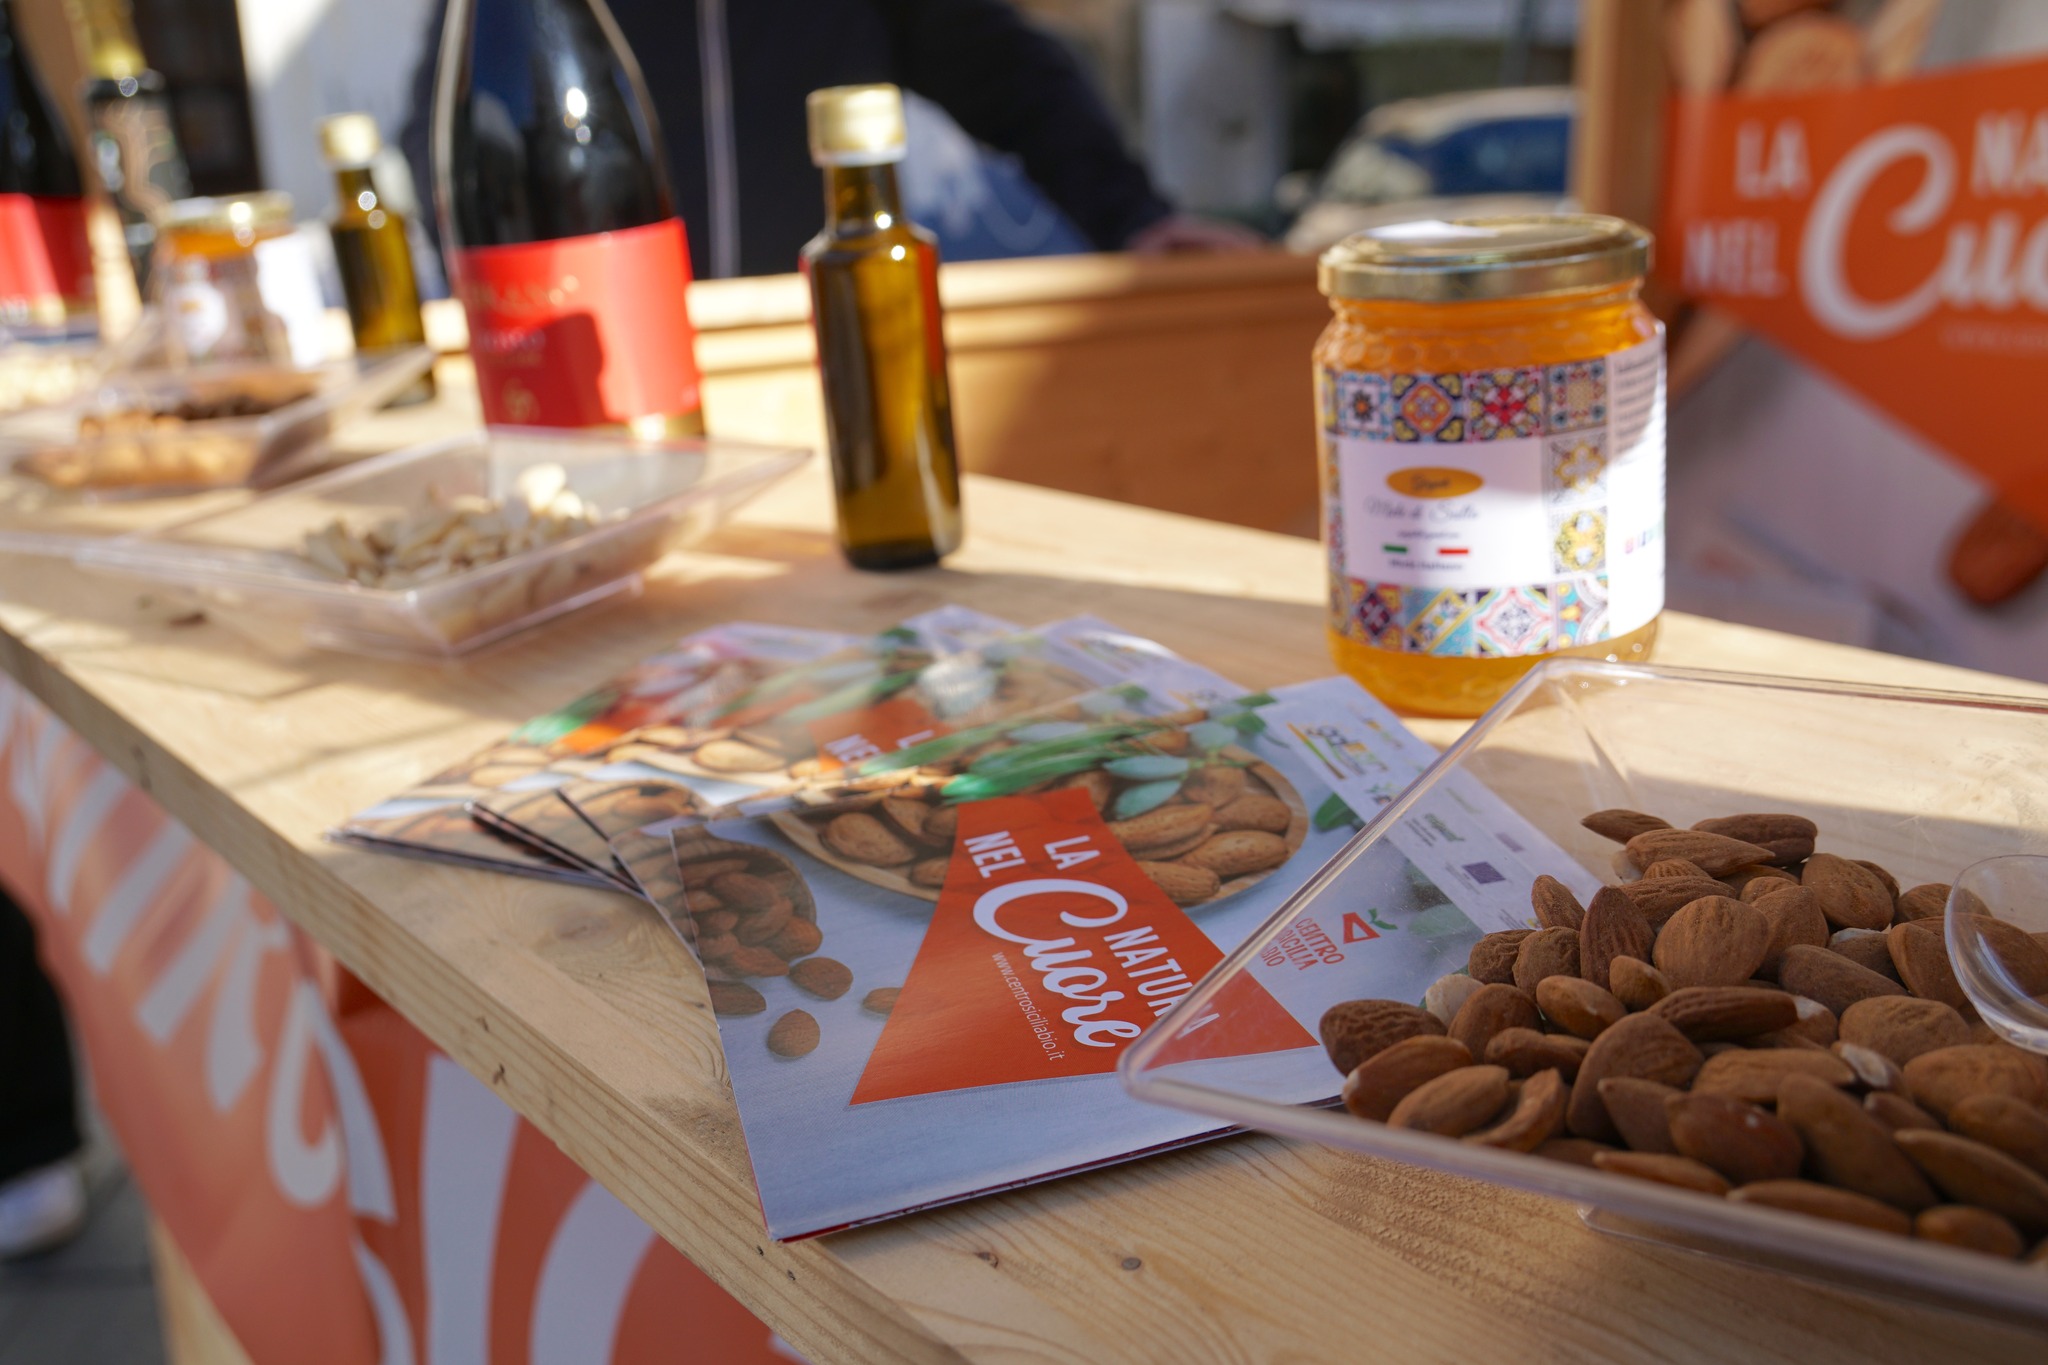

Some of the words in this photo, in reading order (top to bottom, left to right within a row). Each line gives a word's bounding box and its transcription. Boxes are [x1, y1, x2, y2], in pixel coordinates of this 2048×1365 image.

[1734, 117, 1809, 199] LA
[1684, 215, 1784, 299] NEL
[963, 830, 1026, 878] NEL
[1044, 835, 1100, 870] LA
[973, 878, 1142, 1047] Cuore
[1295, 917, 1345, 965] CENTRO
[992, 951, 1065, 1061] www.centrosiciliabio.it
